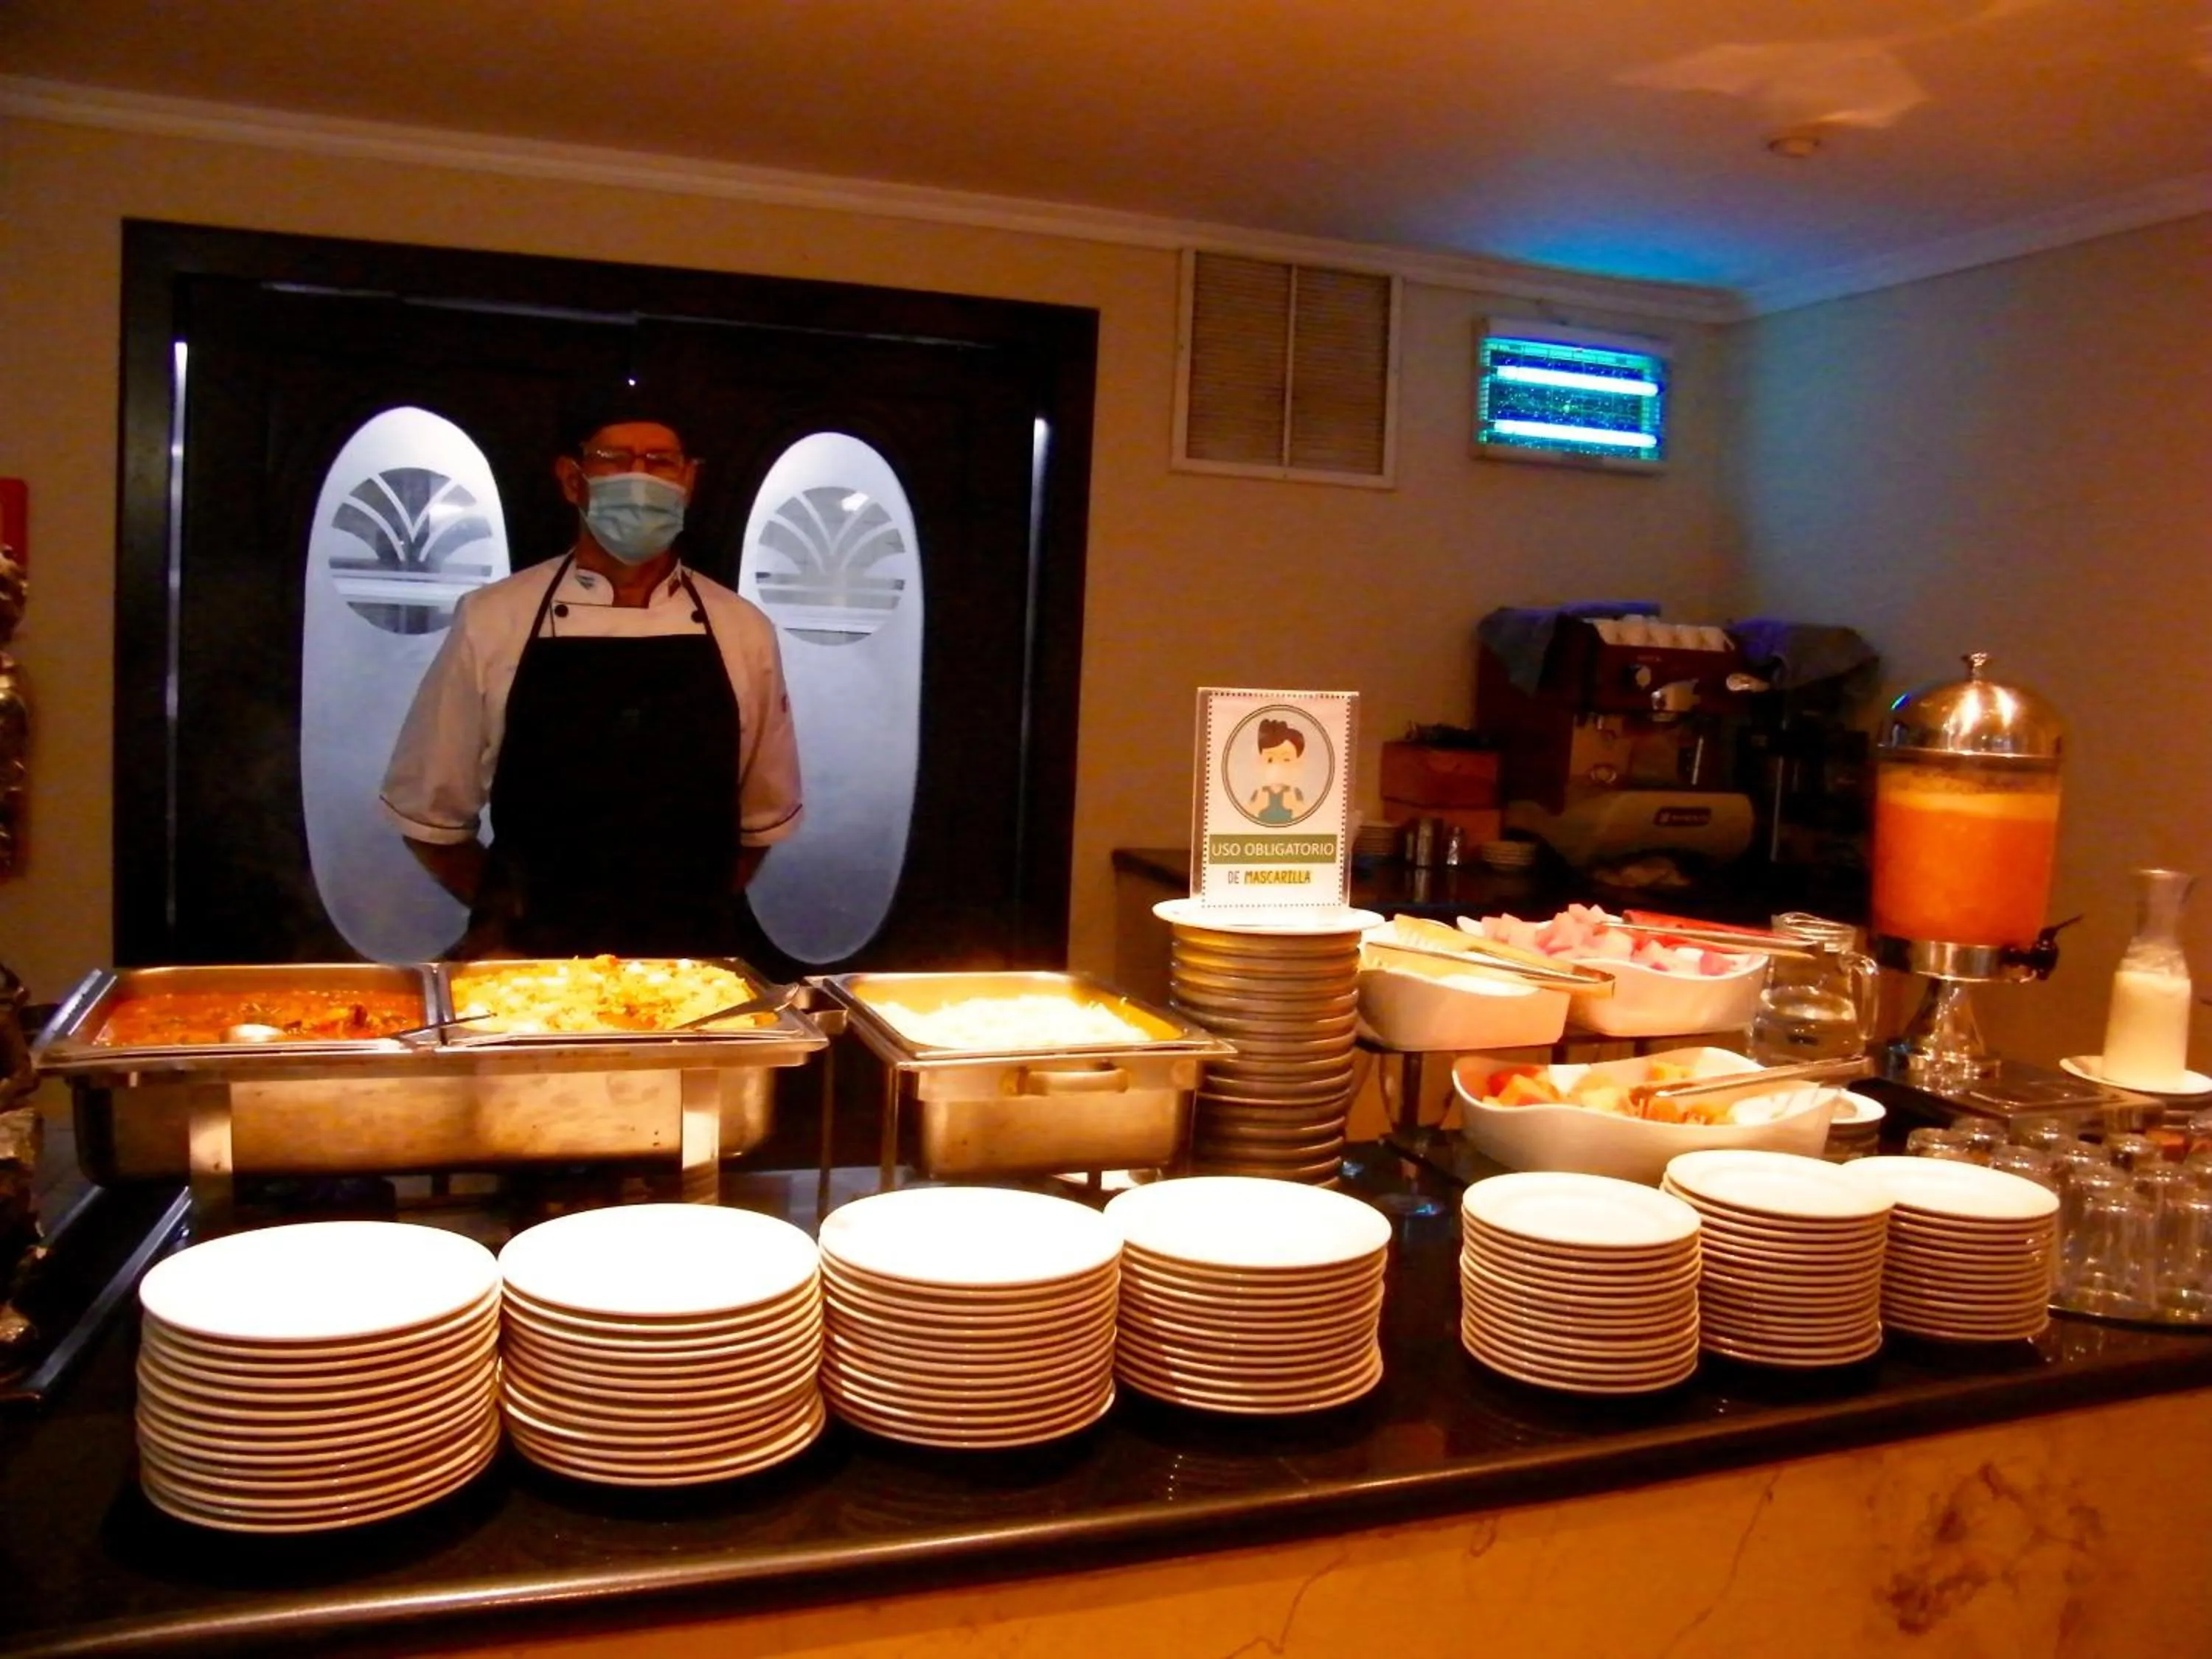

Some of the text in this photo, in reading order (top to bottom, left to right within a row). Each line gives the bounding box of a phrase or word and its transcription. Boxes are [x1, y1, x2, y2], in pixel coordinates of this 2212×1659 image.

[1212, 843, 1334, 856] USO OBLIGATORIO
[1228, 870, 1311, 884] DE MASCARILLA
